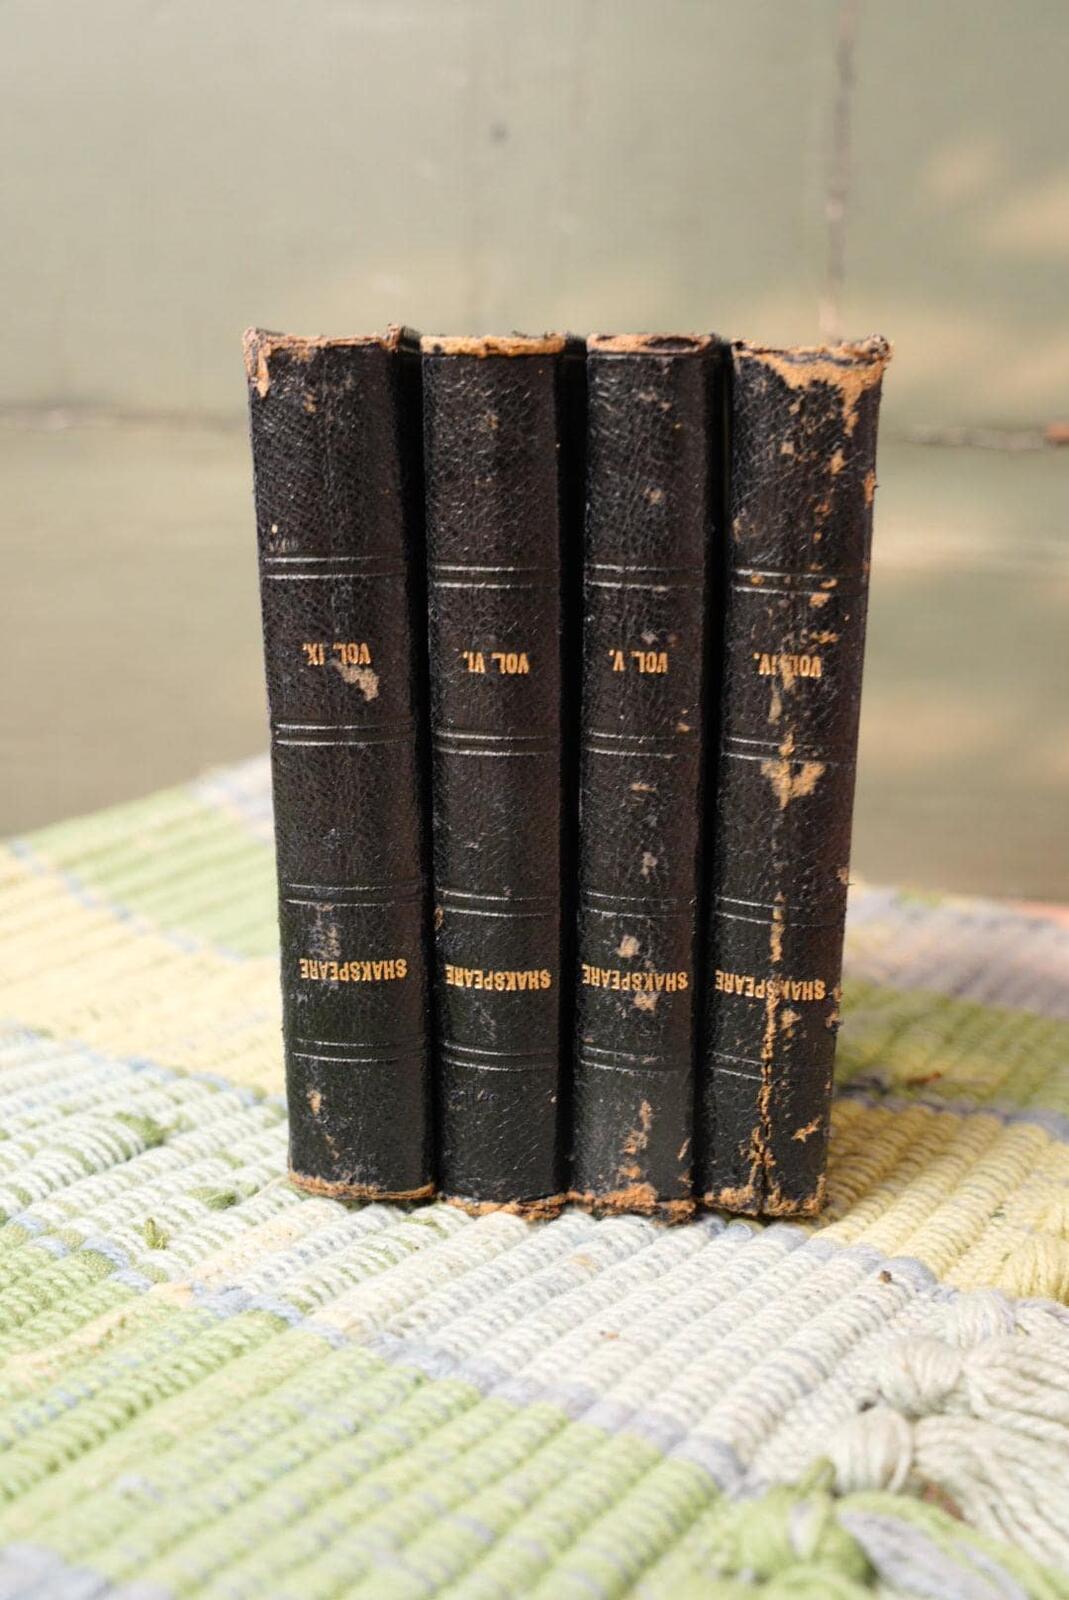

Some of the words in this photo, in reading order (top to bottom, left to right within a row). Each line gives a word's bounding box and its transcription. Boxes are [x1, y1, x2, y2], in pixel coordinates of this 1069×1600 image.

[303, 643, 325, 666] IX.
[333, 643, 371, 665] VOL.
[463, 651, 485, 674] VI.
[491, 652, 530, 674] VOL.
[609, 649, 625, 672] V.
[631, 651, 668, 673] VOL.
[753, 652, 776, 675] IV.
[300, 958, 408, 982] SHAKSPEARE
[445, 963, 551, 991] SHAKSPEARE
[582, 963, 688, 992] SHAKSPEARE
